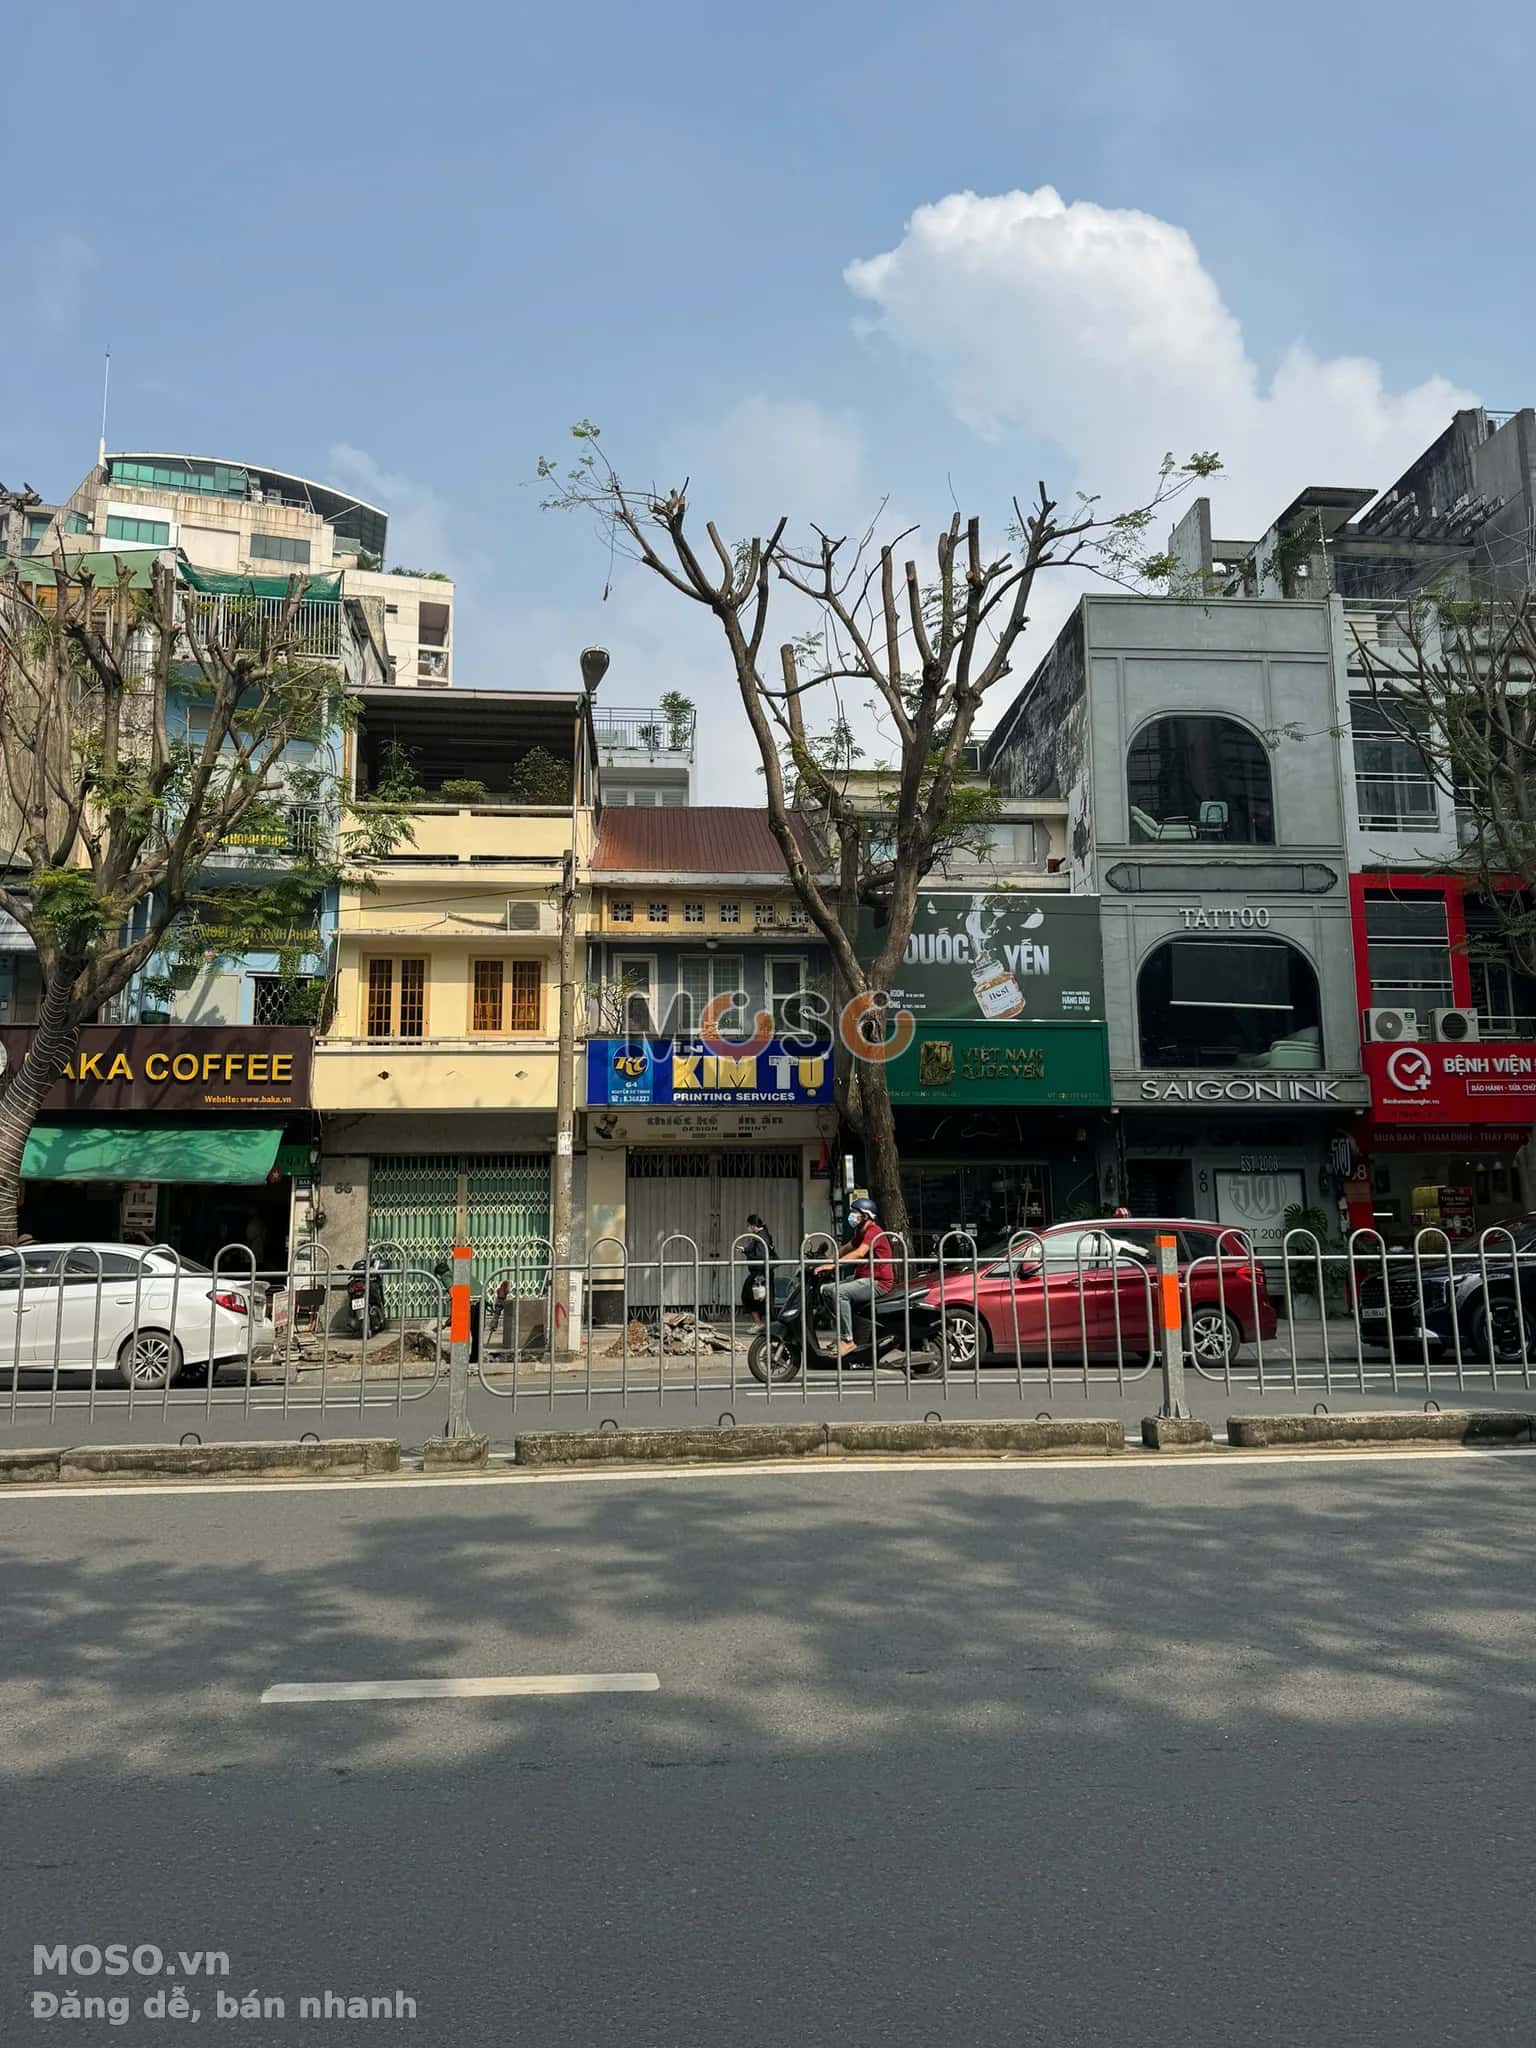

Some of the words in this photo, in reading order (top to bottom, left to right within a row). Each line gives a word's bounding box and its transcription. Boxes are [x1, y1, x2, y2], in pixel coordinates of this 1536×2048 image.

[1180, 907, 1270, 928] TATTOO
[145, 1052, 294, 1082] COFFEE
[672, 1055, 757, 1089] KIM
[1443, 1054, 1489, 1076] BỆNH
[1492, 1054, 1530, 1076] VIỆN
[673, 1092, 732, 1102] PRINTING
[735, 1091, 796, 1102] SERVICES
[1141, 1080, 1281, 1101] SAIGON
[1289, 1080, 1340, 1101] INK
